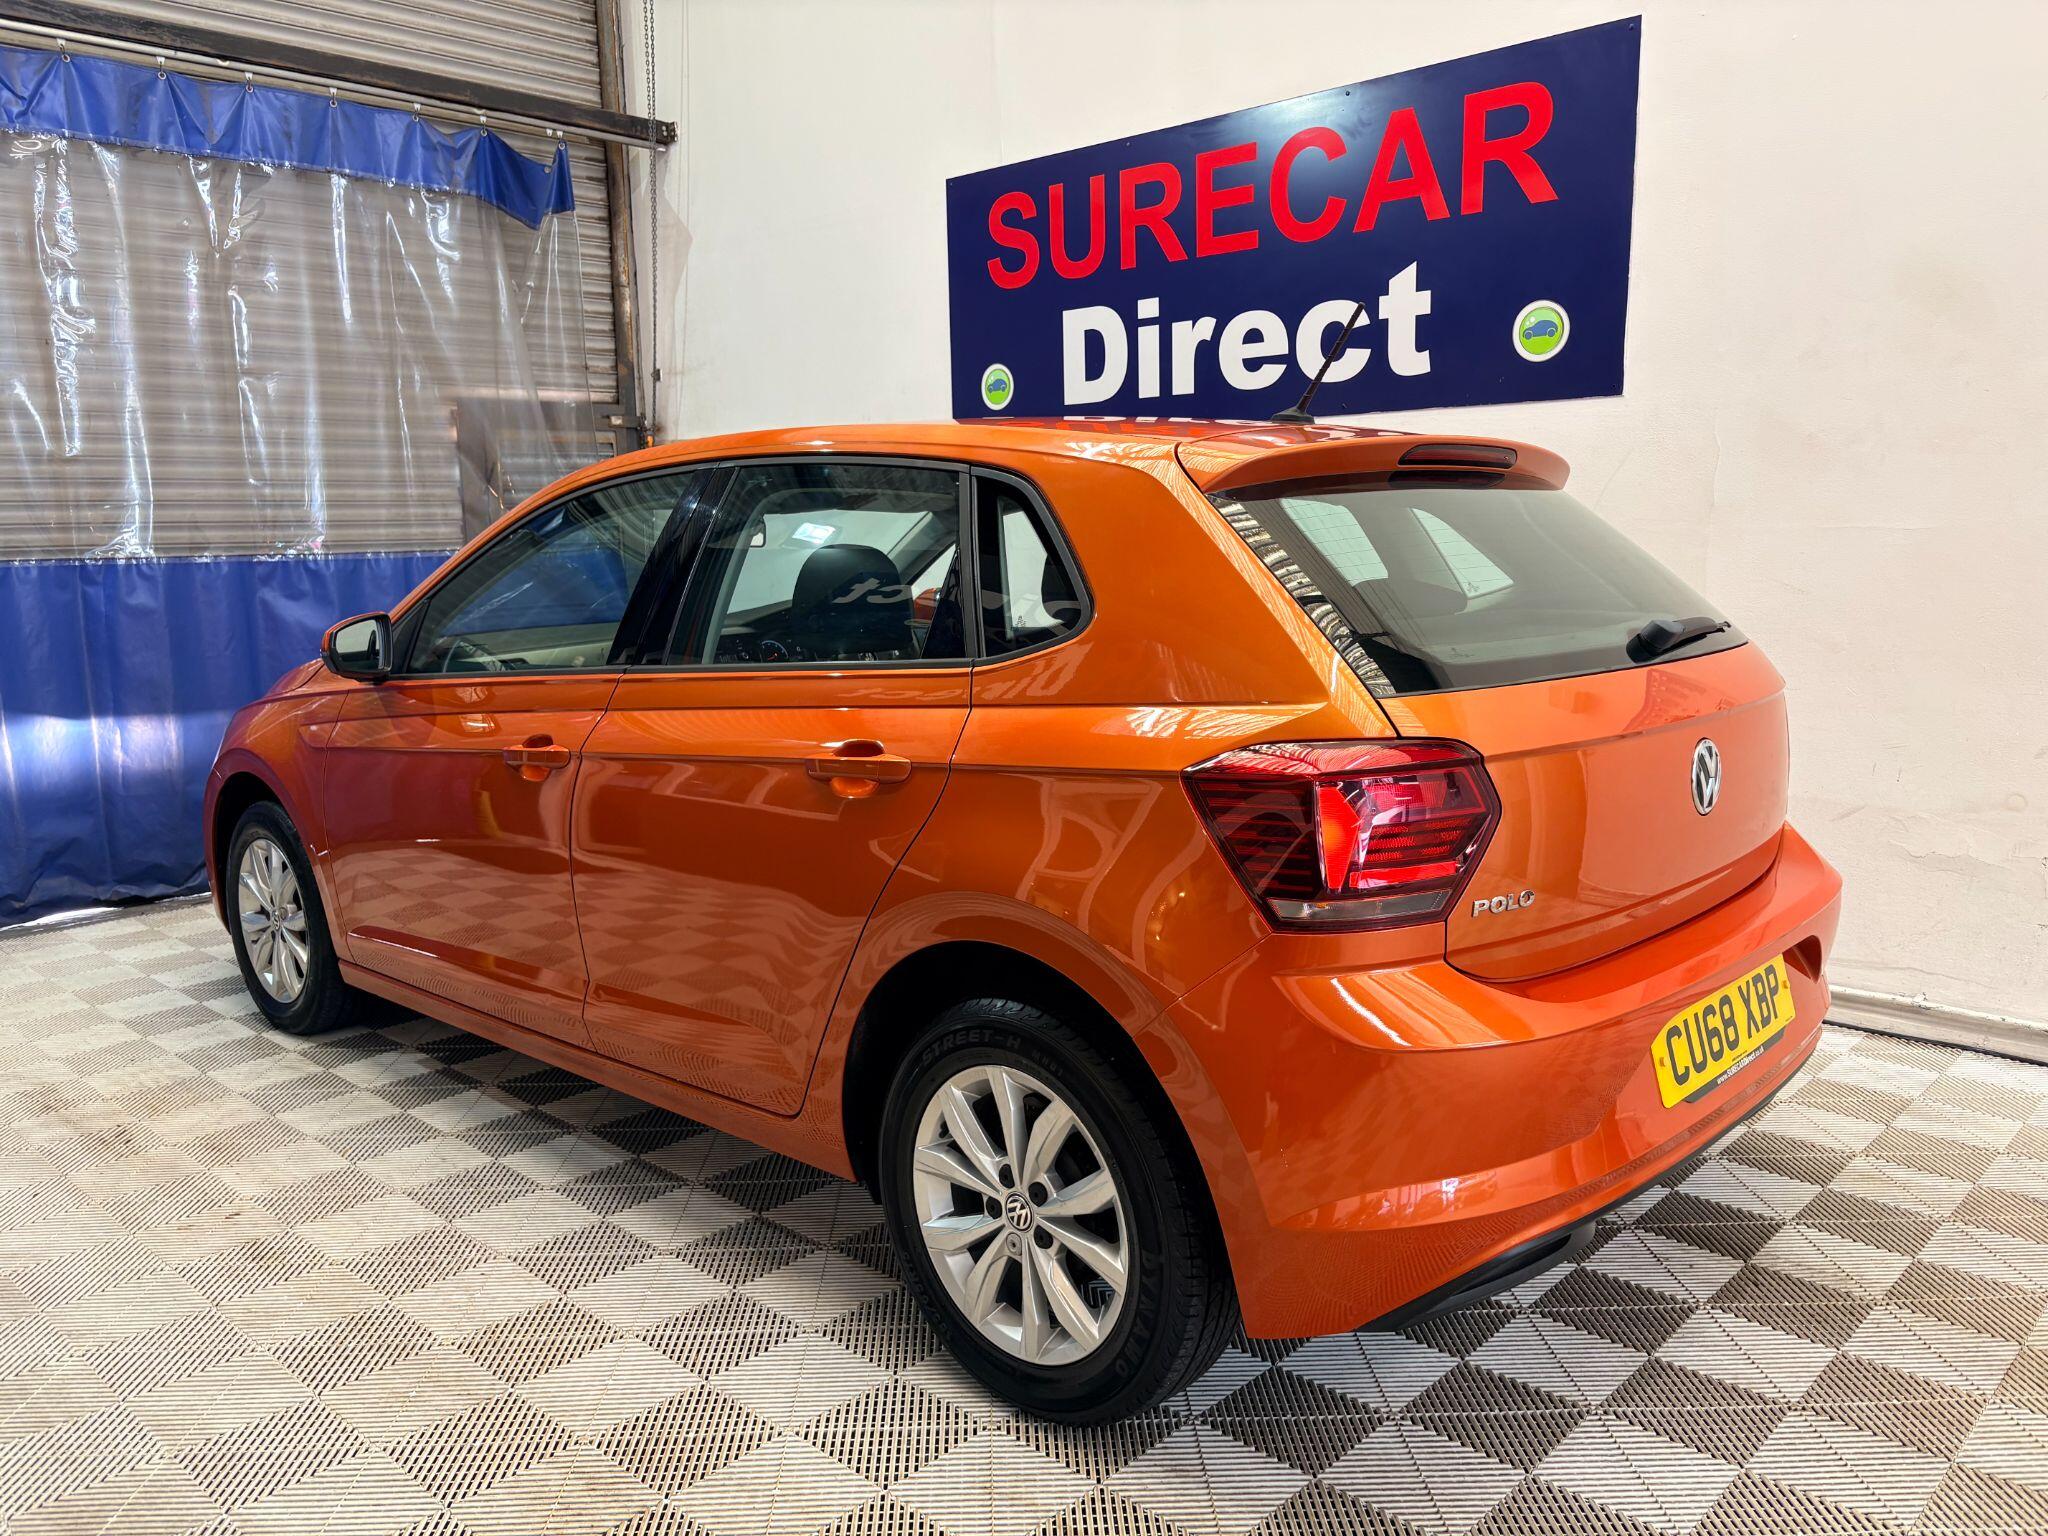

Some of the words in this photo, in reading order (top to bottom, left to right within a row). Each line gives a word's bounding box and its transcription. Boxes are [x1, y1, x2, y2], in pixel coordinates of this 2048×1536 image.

[988, 82, 1558, 290] SURECAR
[1063, 262, 1432, 406] Direct
[1471, 890, 1535, 917] POLO
[922, 1028, 1022, 1067] STREET-H
[1666, 994, 1740, 1086] CU68
[1737, 964, 1779, 1040] XBP
